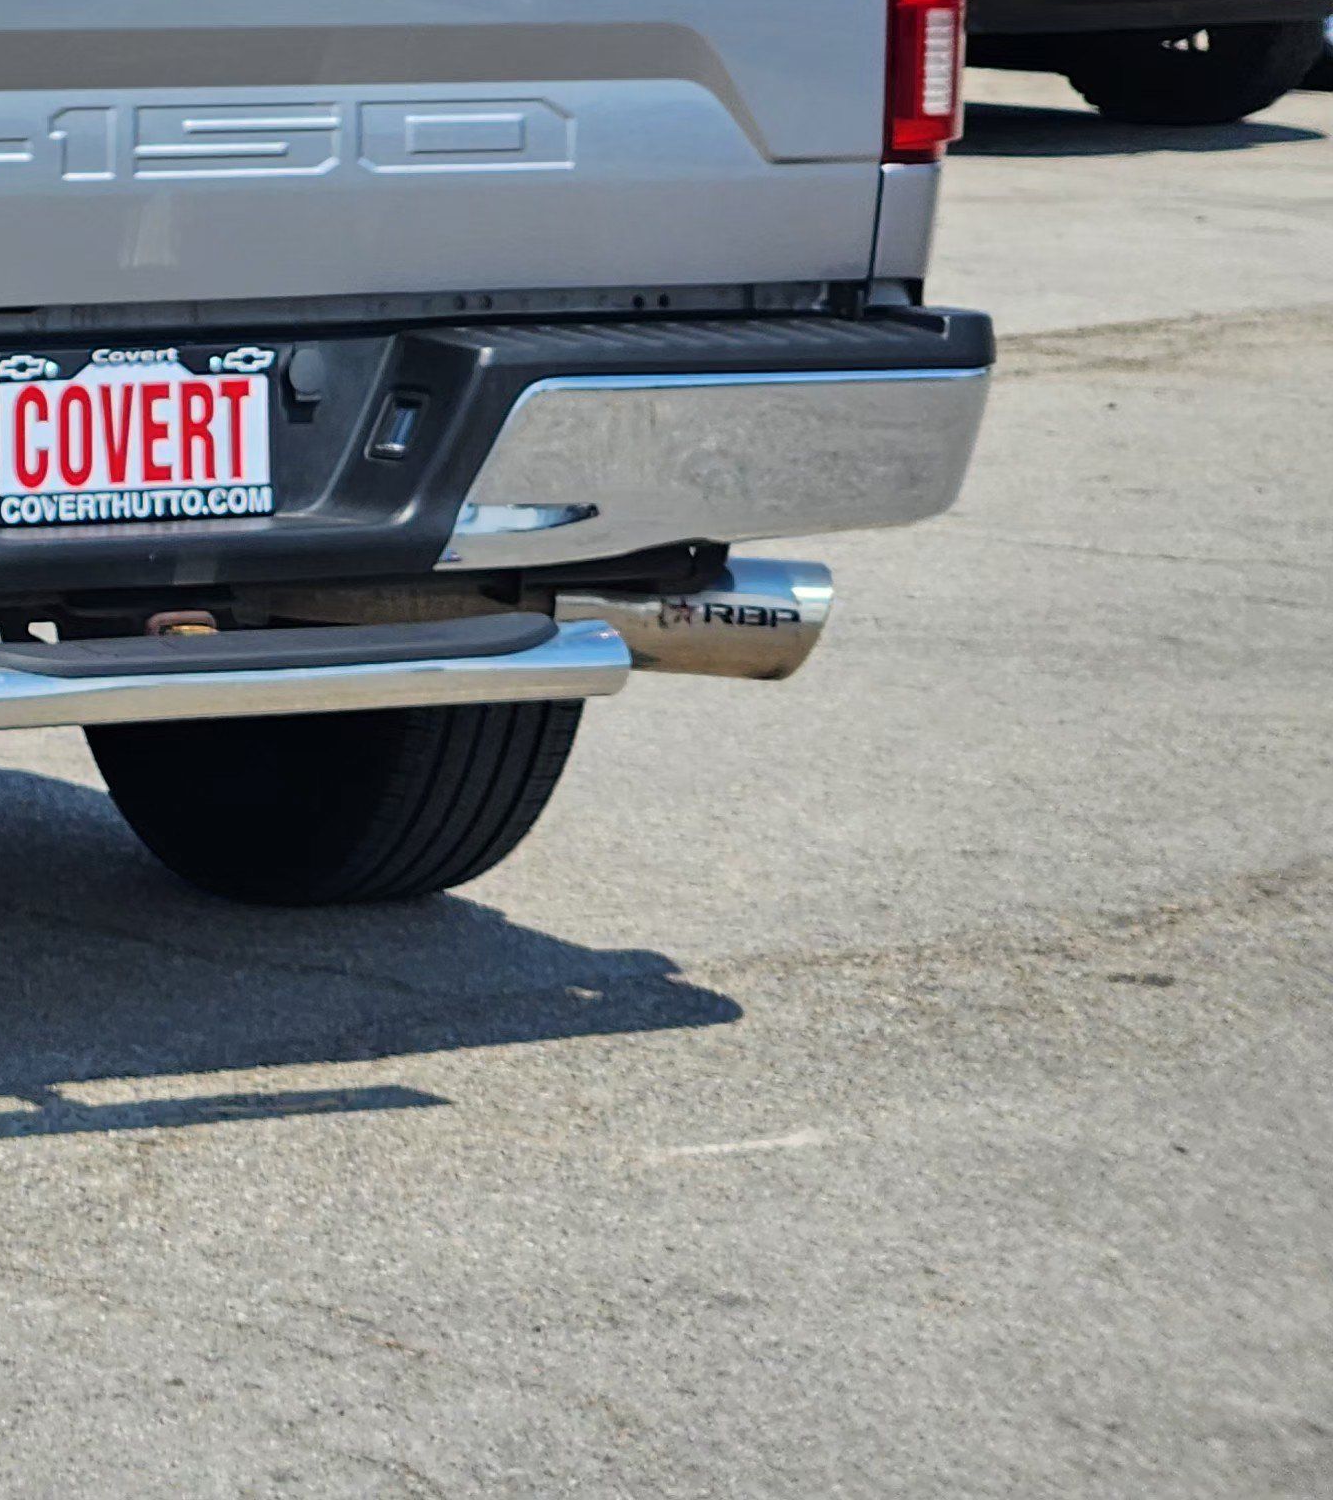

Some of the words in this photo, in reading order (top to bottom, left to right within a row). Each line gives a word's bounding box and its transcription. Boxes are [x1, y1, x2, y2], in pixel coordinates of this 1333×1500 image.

[91, 347, 180, 365] Covert
[14, 379, 251, 489] COVERT
[0, 486, 273, 525] COVERTHUTTO.COM
[703, 602, 801, 628] RBP
